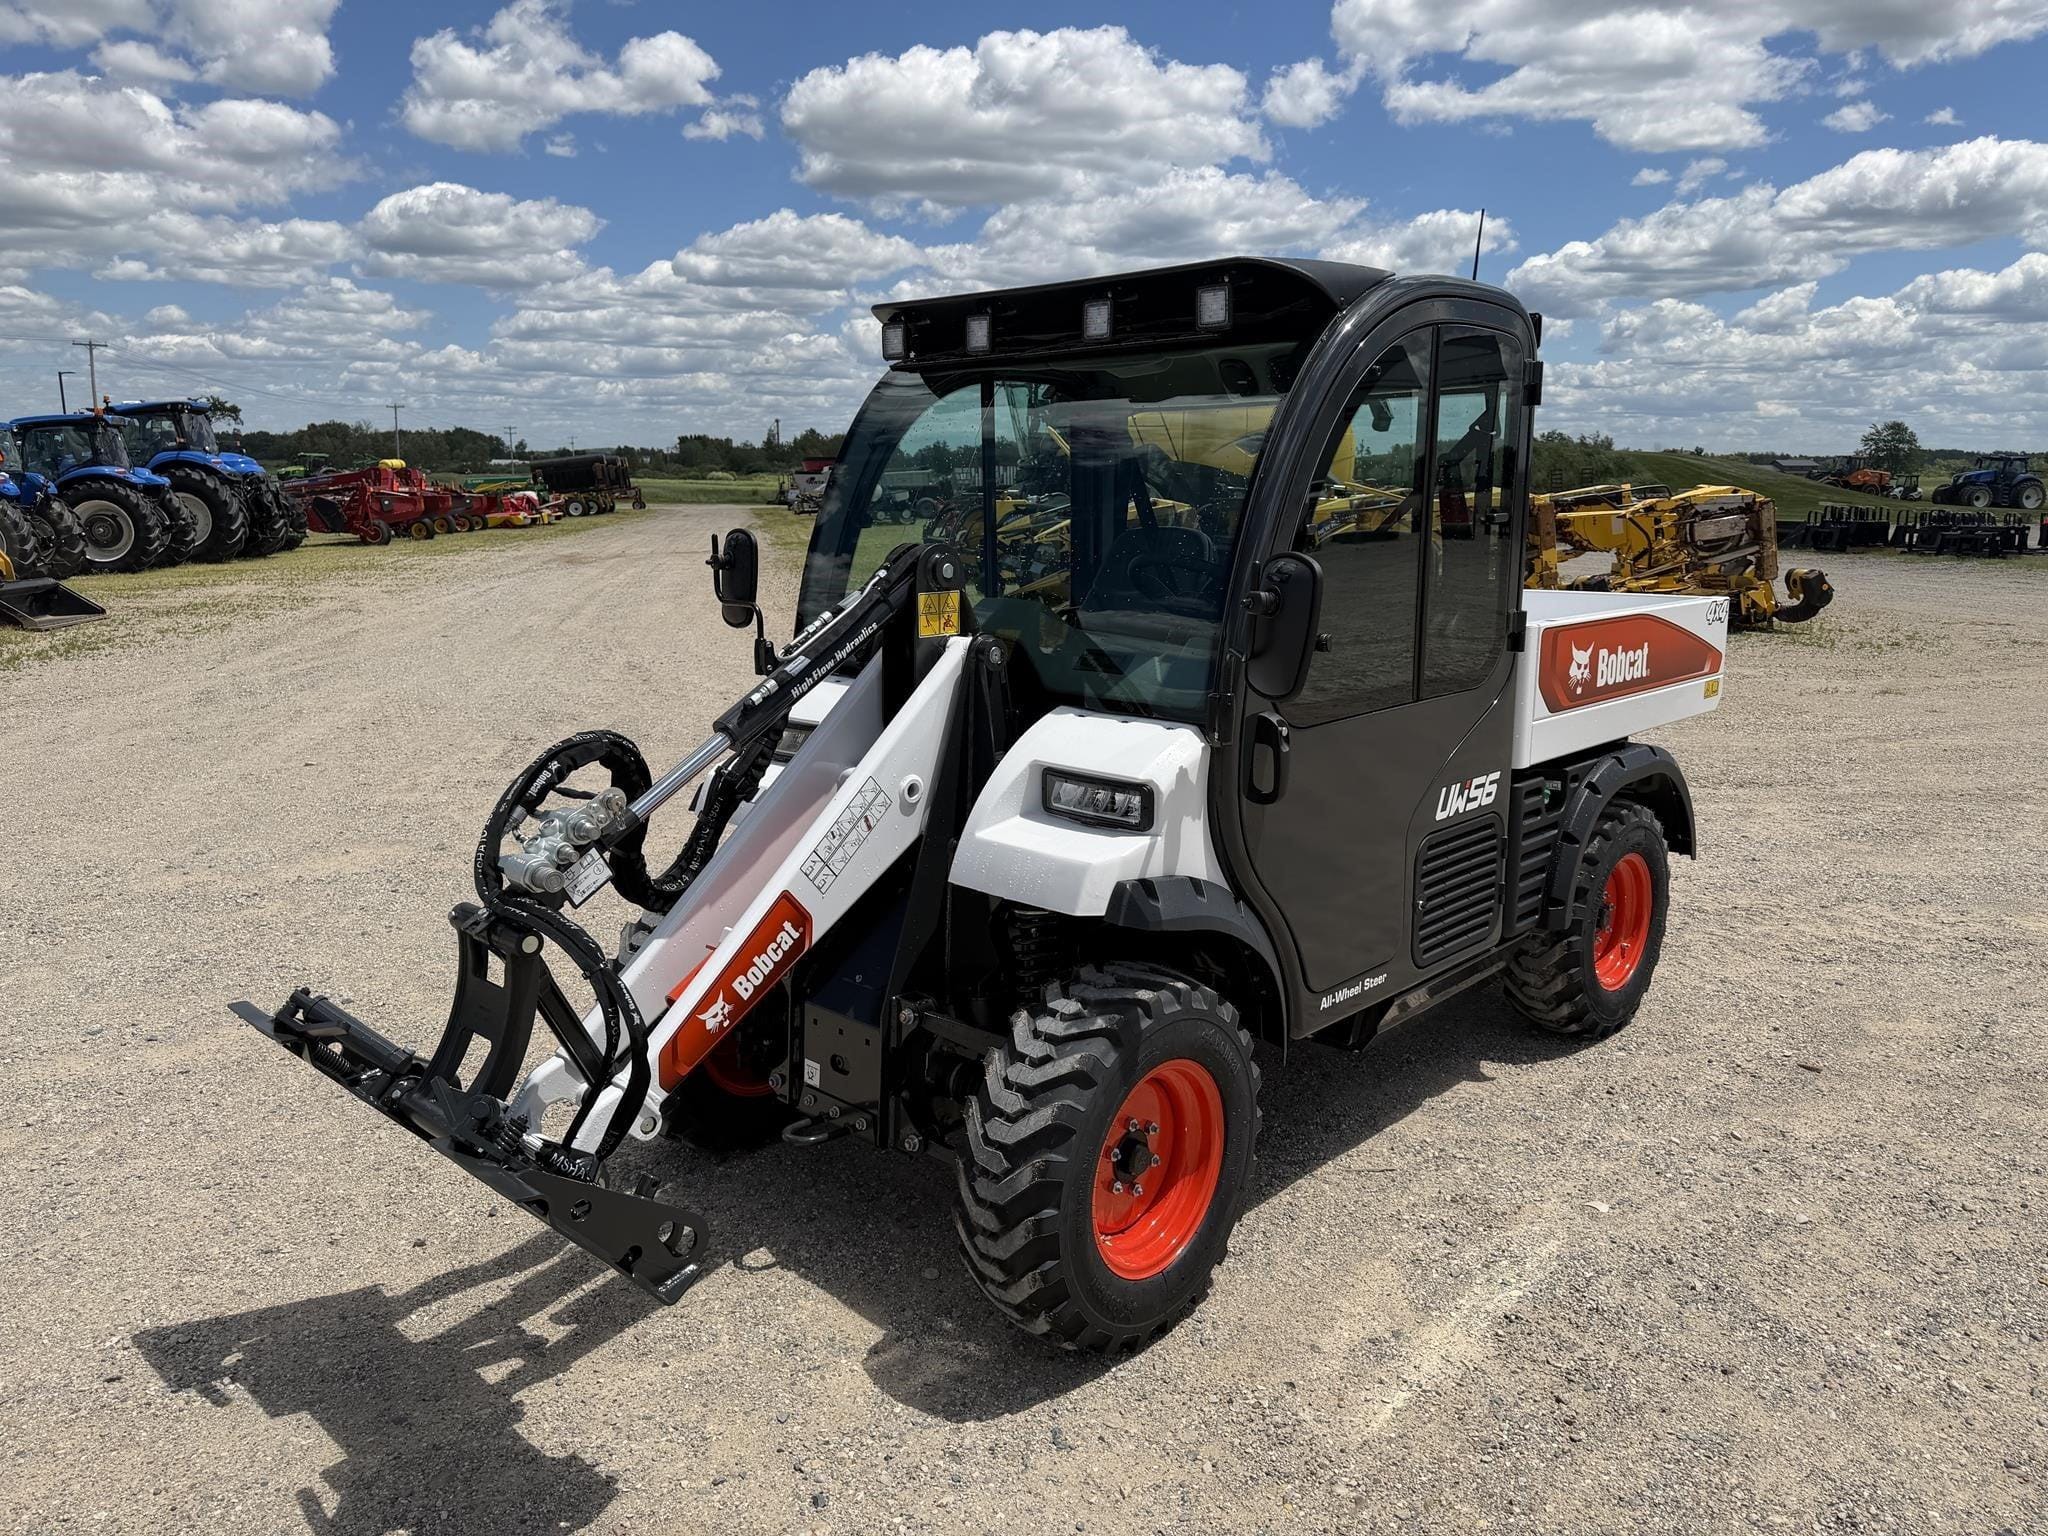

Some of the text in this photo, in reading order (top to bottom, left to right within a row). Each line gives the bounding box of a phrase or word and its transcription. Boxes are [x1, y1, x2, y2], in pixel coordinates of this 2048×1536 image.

[1706, 599, 1729, 625] 4x4
[791, 622, 878, 698] High Flow Hydraulics
[1596, 642, 1649, 688] Bobcat
[530, 769, 552, 798] Bobcat
[1435, 771, 1501, 821] UW56
[731, 920, 800, 1001] Bobcat
[1320, 973, 1388, 1011] All-Wheel Steer
[550, 1152, 586, 1179] MSHA
